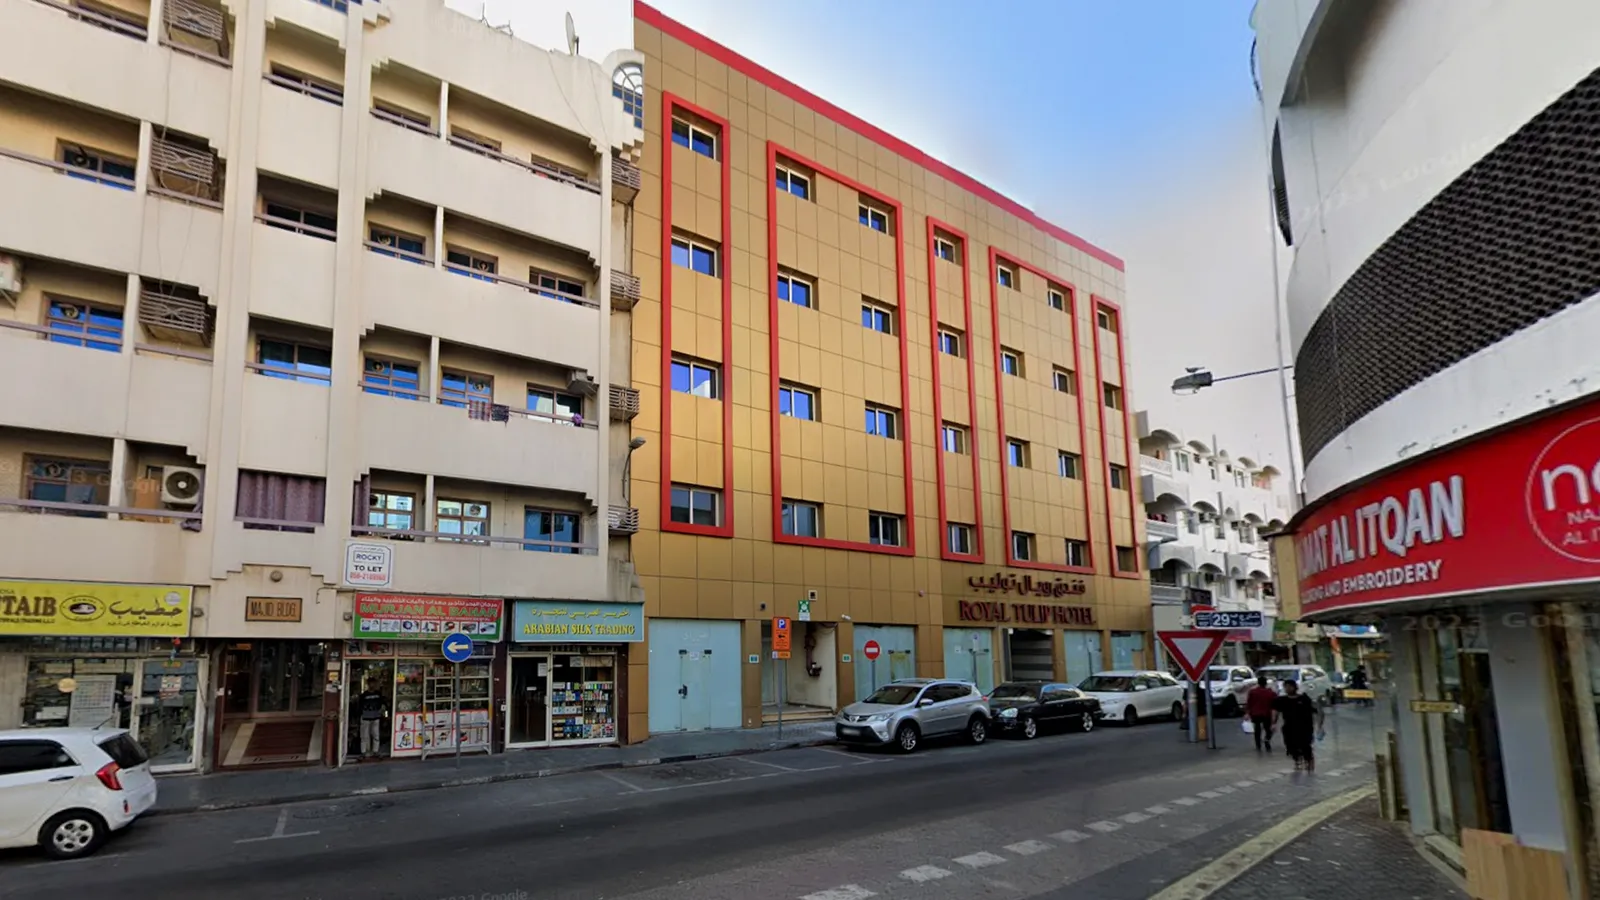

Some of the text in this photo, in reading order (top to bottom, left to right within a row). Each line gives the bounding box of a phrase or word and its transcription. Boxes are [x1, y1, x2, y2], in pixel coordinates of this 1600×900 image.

[1331, 515, 1356, 566] AL
[1356, 475, 1464, 558] ITQAN
[356, 553, 382, 561] ROCKY
[968, 573, 1017, 593] توليب
[1342, 559, 1442, 594] EMBROIDERY
[360, 602, 425, 615] MURJAN
[427, 605, 446, 616] AL
[959, 600, 1096, 625] ROYAL TULIP HOTEL
[1212, 613, 1230, 626] 29
[523, 623, 636, 635] ARABIAN SILK TRADING
